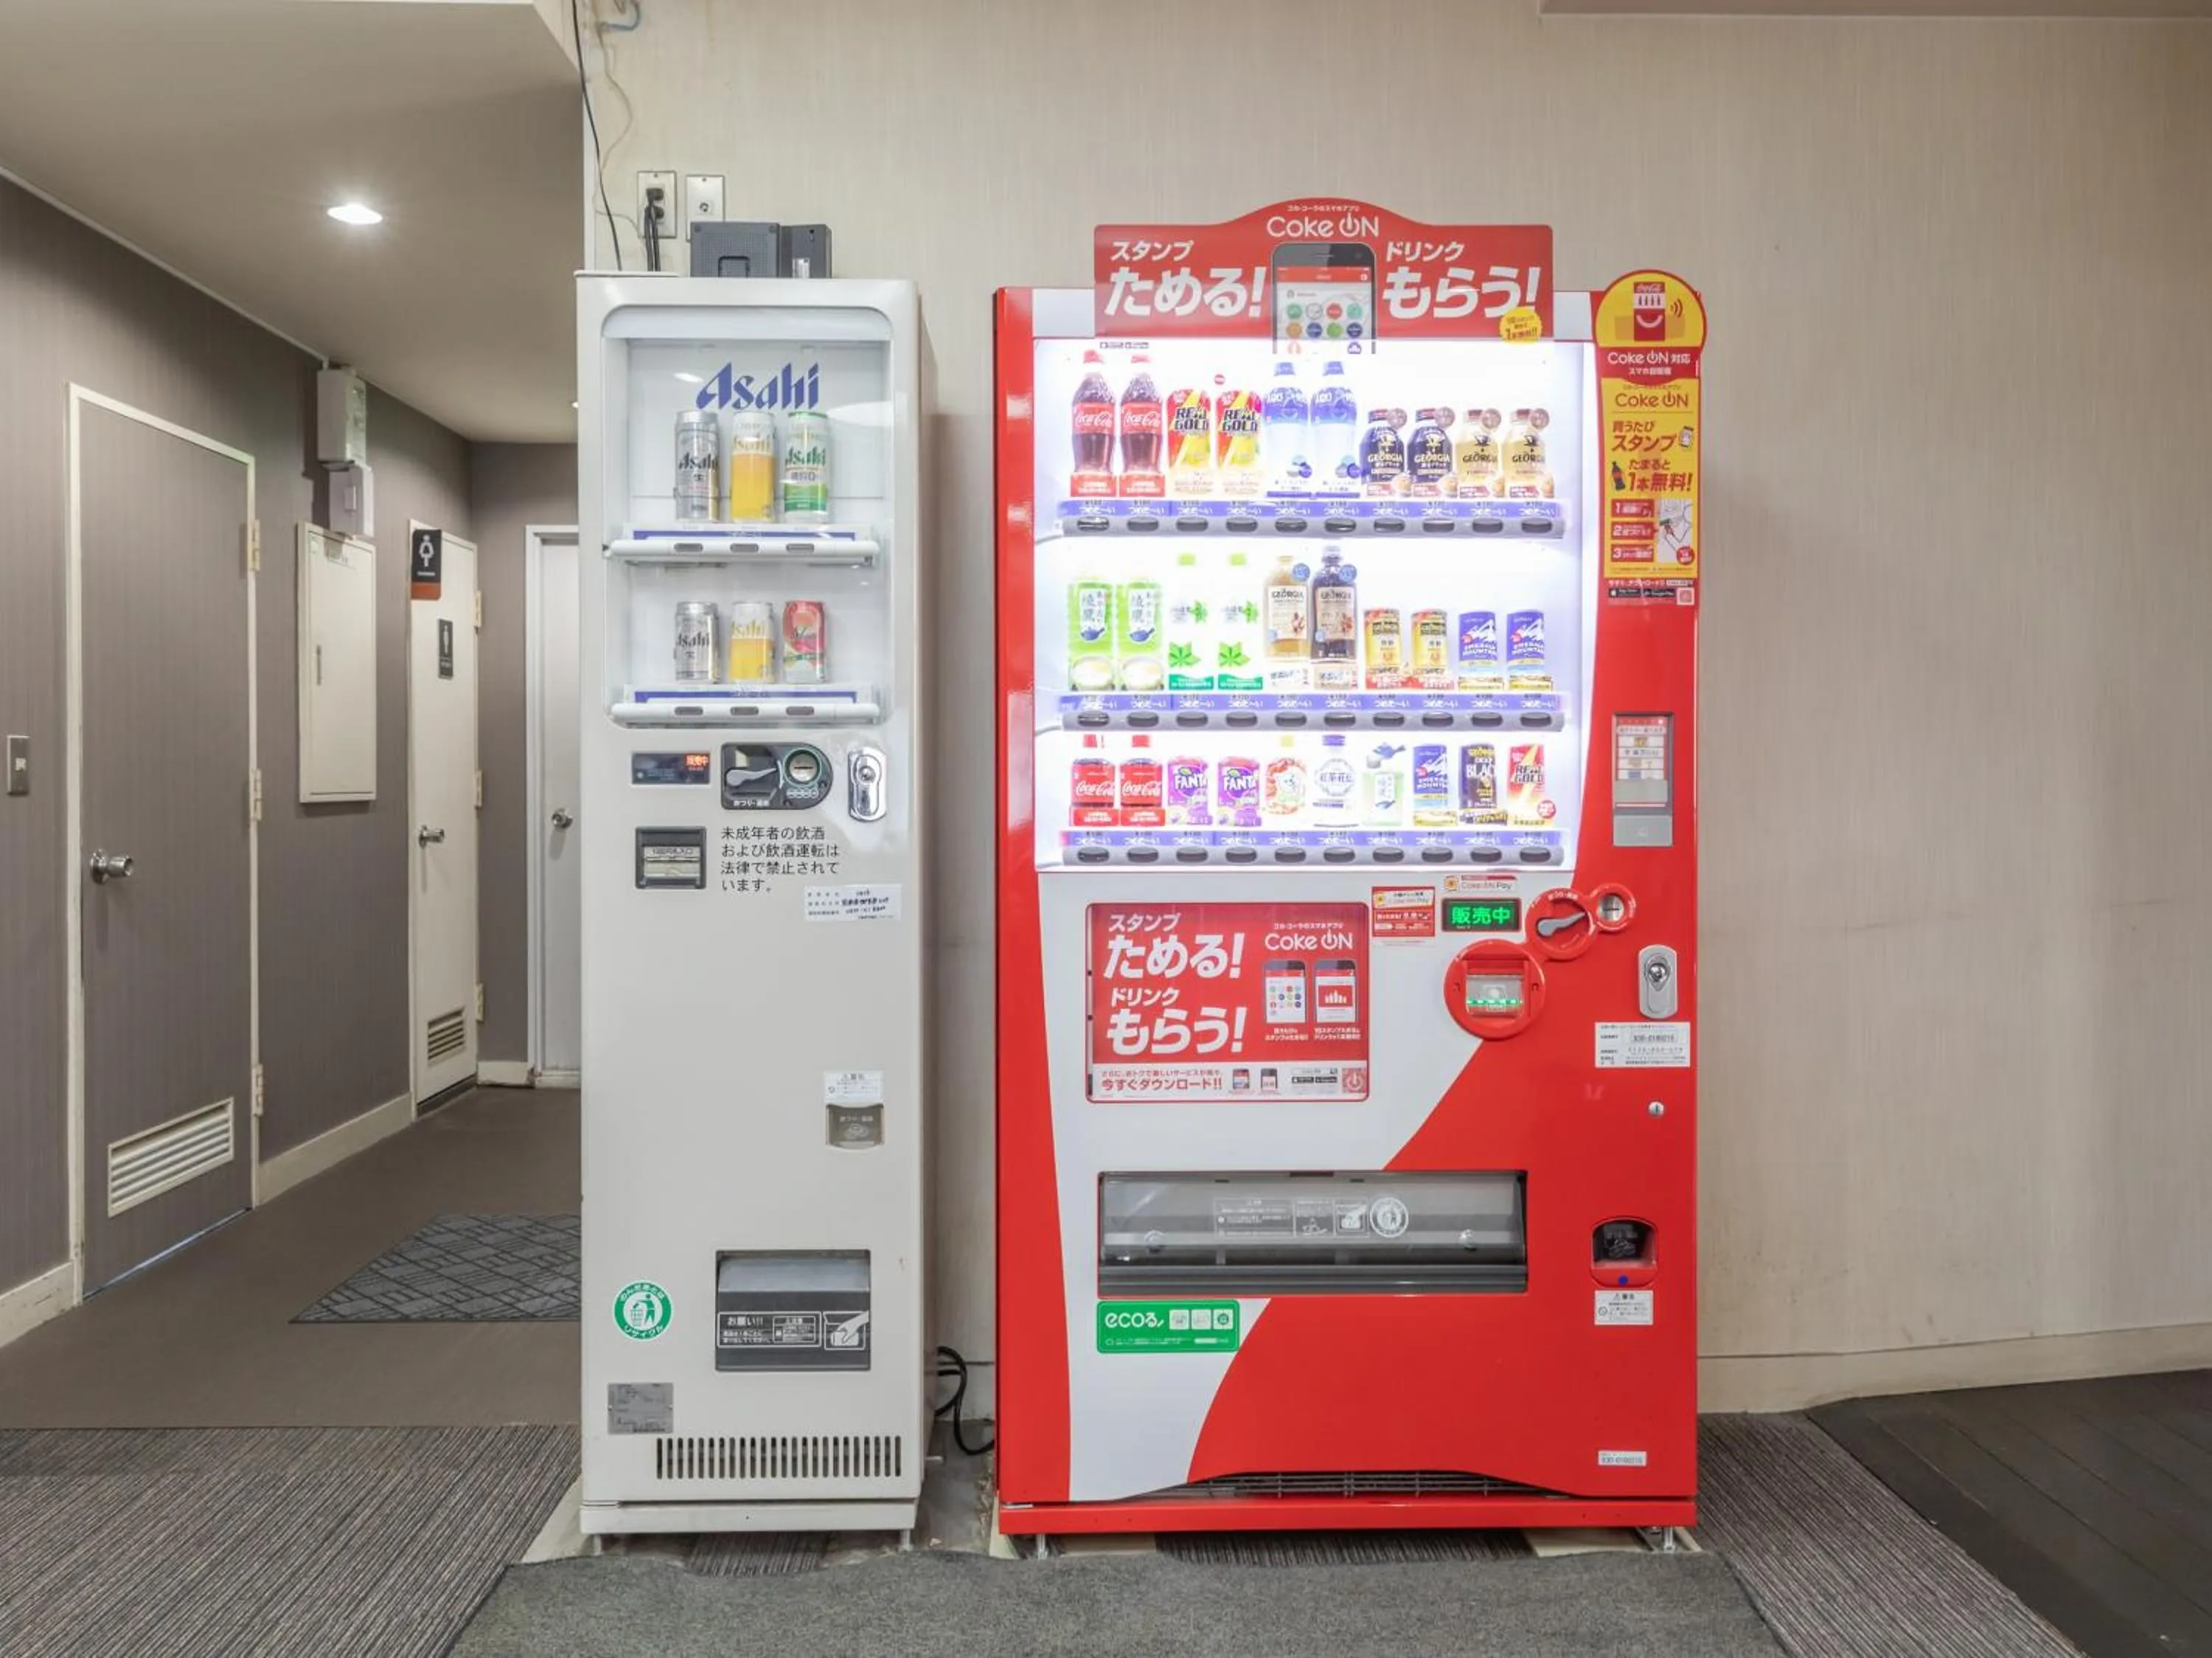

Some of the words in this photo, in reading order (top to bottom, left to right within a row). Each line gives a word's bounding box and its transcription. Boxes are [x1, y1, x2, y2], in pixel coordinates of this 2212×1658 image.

[1267, 215, 1334, 237] Coke
[1339, 212, 1379, 237] ON
[1110, 240, 1194, 262] スタンプ
[1386, 241, 1464, 262] ドリンク
[1105, 266, 1267, 318] ためる!
[1382, 266, 1541, 319] もらう!
[1607, 352, 1645, 364] Coke
[1646, 349, 1669, 364] ON
[695, 361, 821, 411] Asahi
[1615, 392, 1659, 407] Coke
[1663, 391, 1688, 407] ON
[1613, 421, 1655, 433] 買うたび
[1612, 434, 1677, 452] スタンプ
[1629, 459, 1671, 471] たまると
[1628, 473, 1693, 492] 1本無料!
[721, 826, 825, 840] 未成年者の飲酒
[721, 843, 840, 857] および飲酒運転は
[720, 861, 840, 874] 法律で禁止されて
[722, 879, 772, 892] います。
[1108, 913, 1181, 932] スタンプ
[1451, 906, 1511, 924] 販売中
[1265, 932, 1318, 951] Coke
[1321, 929, 1353, 951] ON
[1103, 932, 1245, 979] ためる!
[1110, 987, 1180, 1007] ドリンク
[1107, 1006, 1248, 1055] もらう!
[1102, 1078, 1222, 1092] 今すぐダウンロード!!
